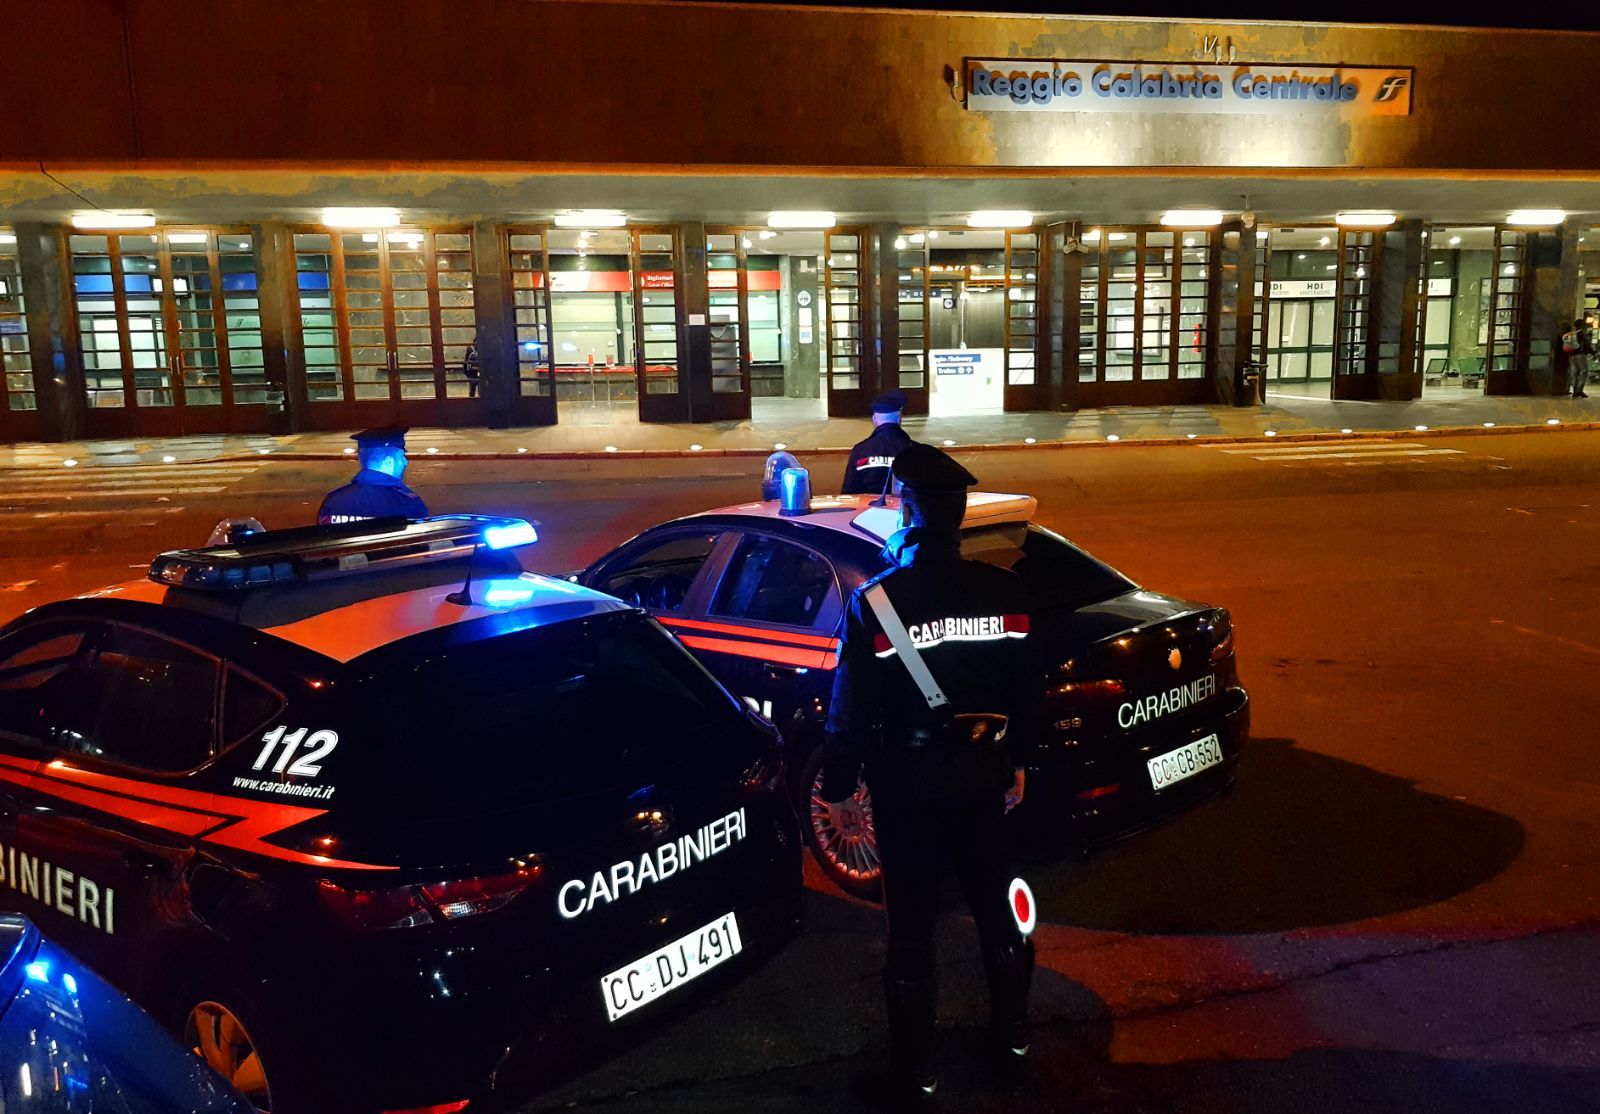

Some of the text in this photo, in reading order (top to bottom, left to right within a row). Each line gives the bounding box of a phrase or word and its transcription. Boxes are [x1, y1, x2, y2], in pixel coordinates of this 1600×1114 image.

[971, 68, 1358, 104] Reggio Calabria Centrale
[908, 615, 1004, 643] CARABINIERI
[1118, 673, 1216, 728] CARABINIERI
[252, 725, 339, 777] 112
[1152, 758, 1172, 785] CC
[1199, 737, 1220, 766] 552
[232, 776, 336, 799] www.carabinieri.it
[557, 807, 746, 919] CARABINIERI
[610, 920, 735, 1011] CC DJ 491
